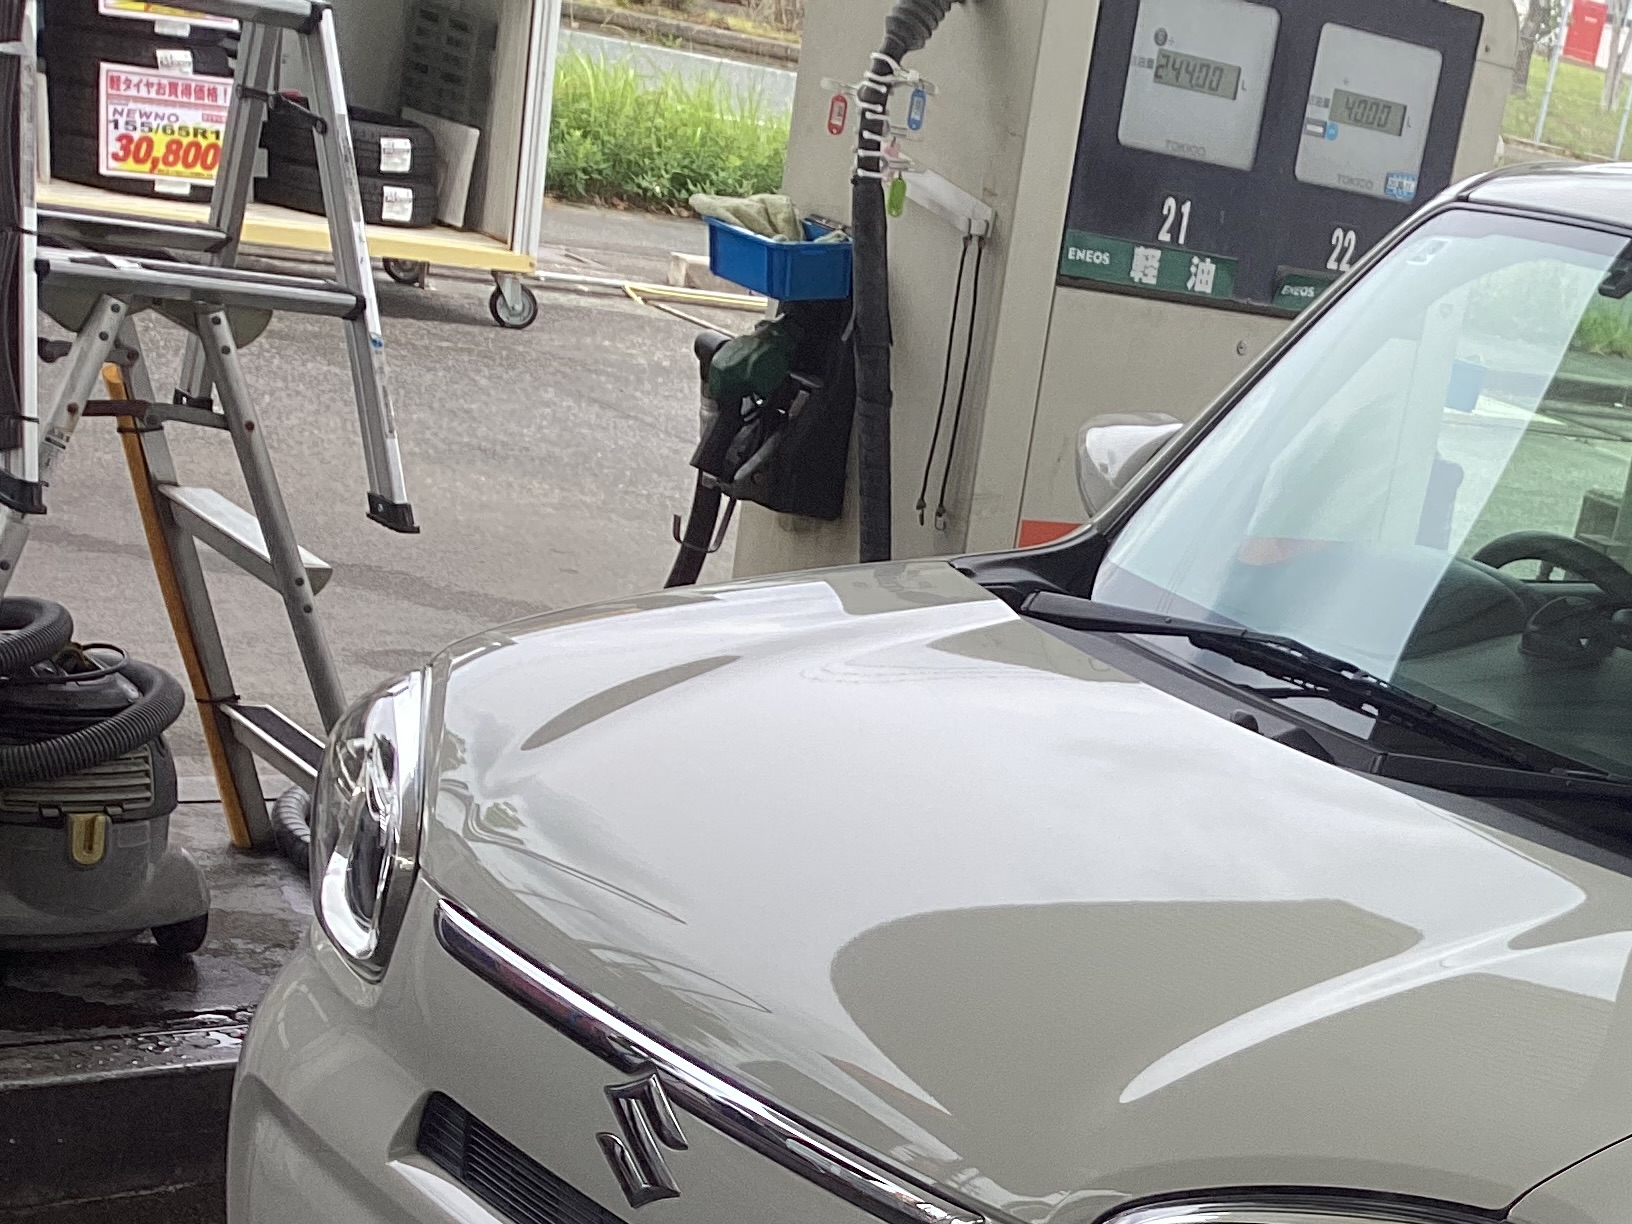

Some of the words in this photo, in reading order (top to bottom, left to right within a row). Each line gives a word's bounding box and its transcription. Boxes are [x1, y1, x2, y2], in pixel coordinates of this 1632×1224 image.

[109, 119, 221, 141] 155/65R1
[112, 107, 180, 123] NEWNO
[111, 133, 222, 174] 30,800
[1337, 173, 1374, 190] TOKICO
[1157, 195, 1192, 245] 21
[1326, 228, 1356, 272] 22
[1067, 247, 1110, 265] ENEOS
[1129, 246, 1216, 293] 軽油
[1281, 285, 1315, 298] ENEOS
